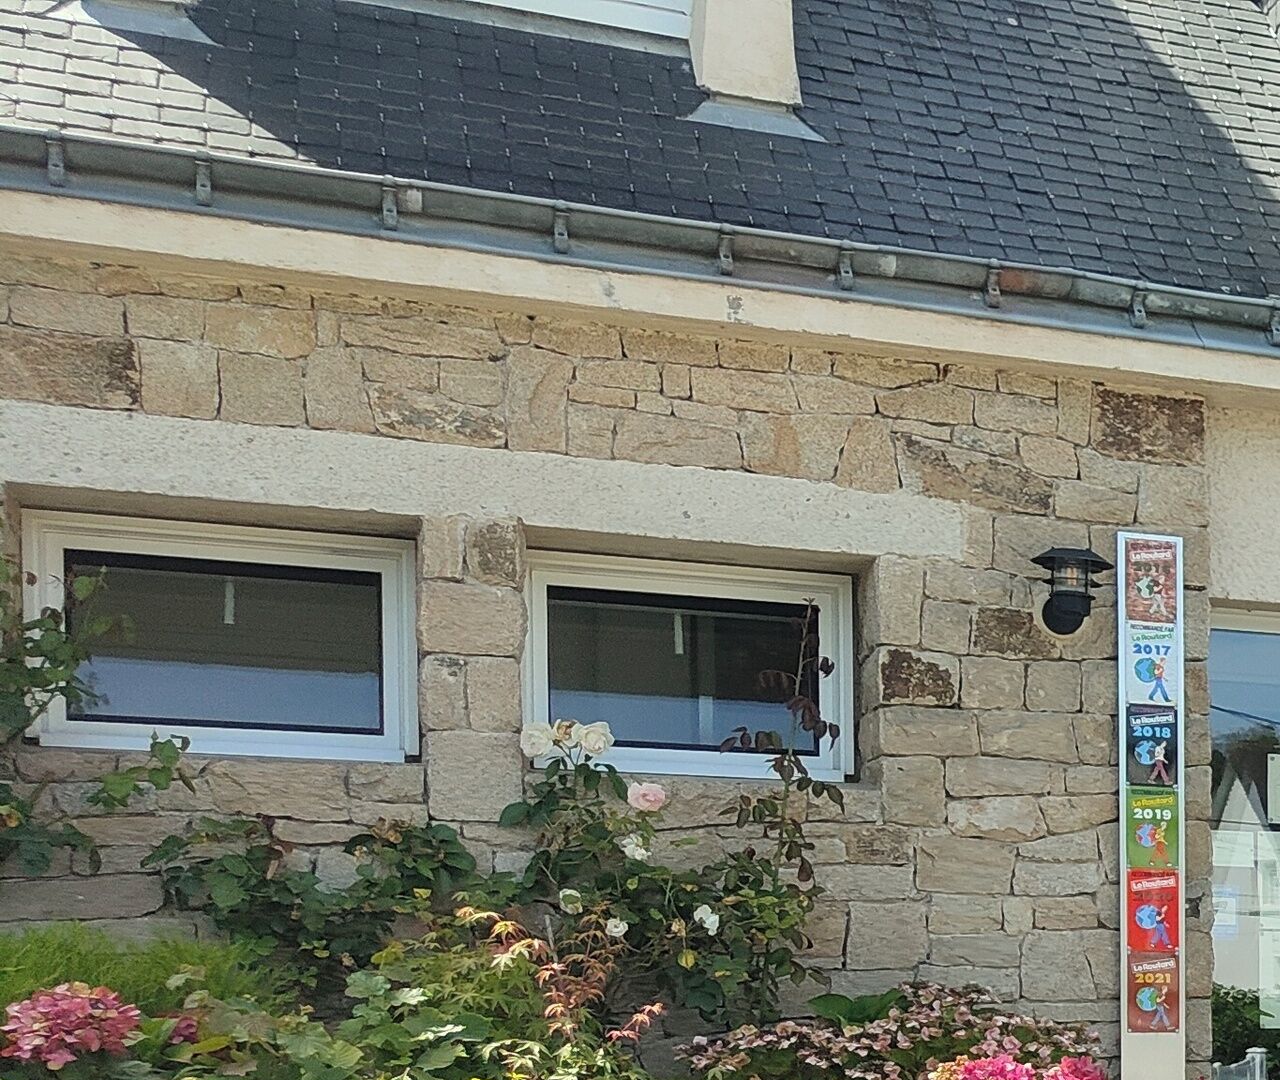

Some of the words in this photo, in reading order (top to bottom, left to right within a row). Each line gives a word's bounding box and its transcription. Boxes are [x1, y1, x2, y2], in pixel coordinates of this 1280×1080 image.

[1141, 632, 1172, 641] Routard
[1132, 643, 1171, 656] 2017
[1141, 714, 1173, 724] Routard
[1132, 726, 1171, 738] 2018
[1141, 796, 1173, 806] Routard
[1133, 807, 1172, 820] 2019
[1132, 881, 1142, 890] Le
[1142, 878, 1174, 888] Routard
[1133, 963, 1143, 972] Le
[1143, 960, 1174, 971] Routard
[1134, 973, 1171, 983] 2021
